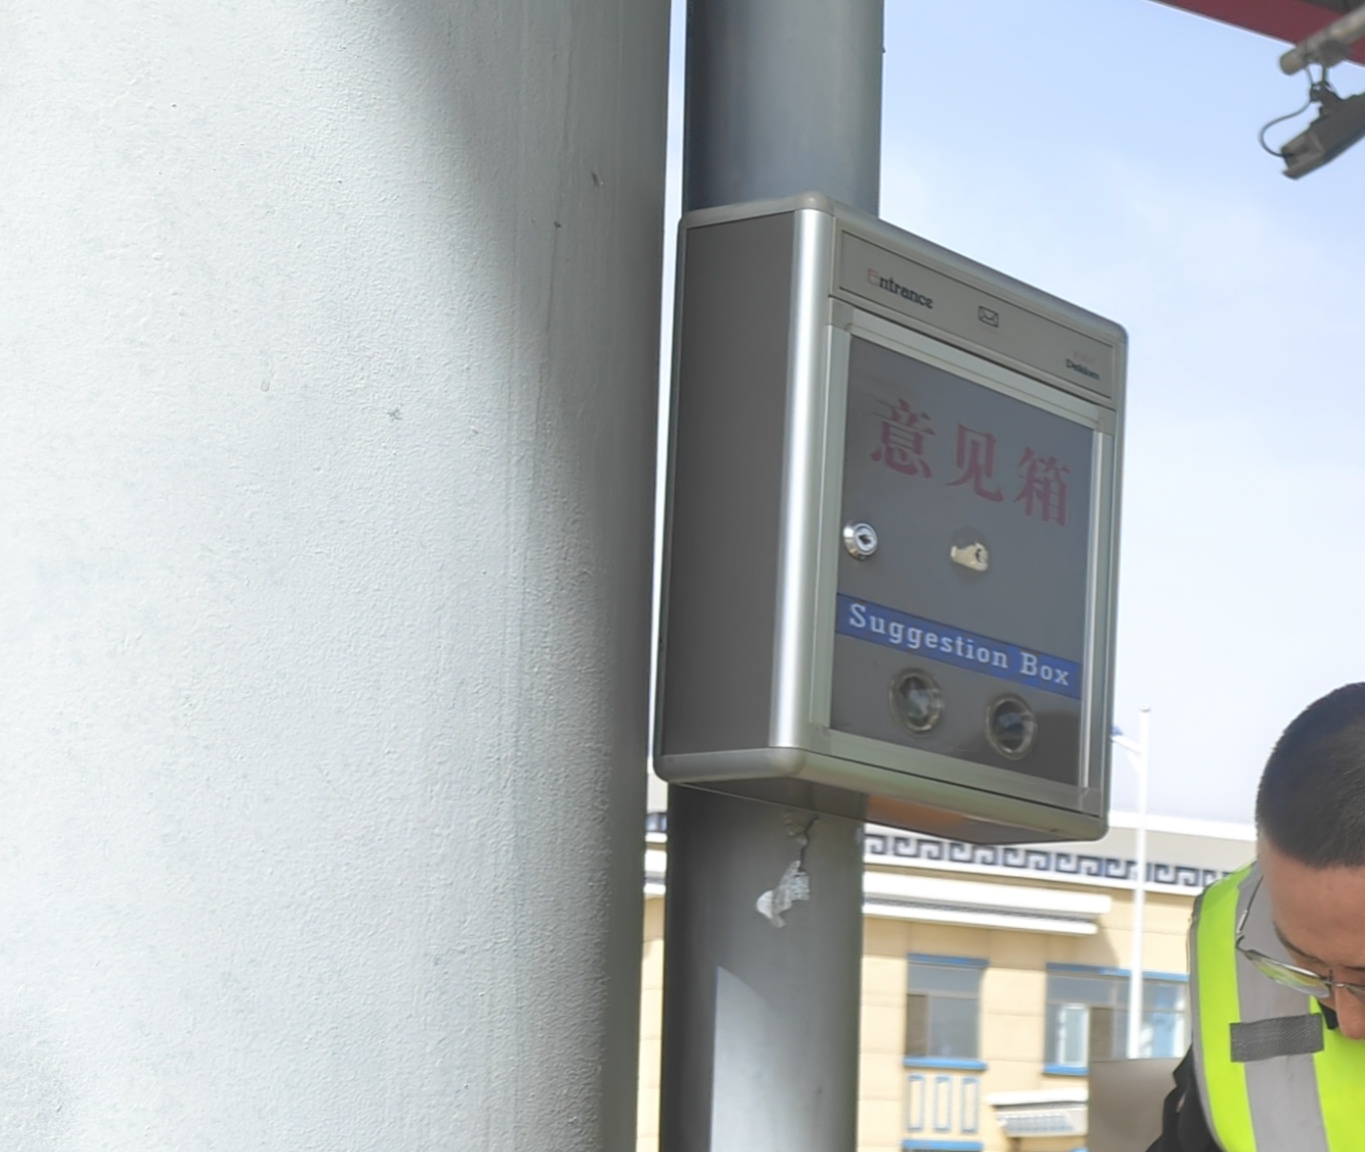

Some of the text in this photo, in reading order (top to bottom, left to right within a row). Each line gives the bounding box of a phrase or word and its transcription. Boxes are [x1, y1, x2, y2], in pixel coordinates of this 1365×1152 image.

[867, 268, 933, 309] Entrance
[870, 399, 1070, 526] 意见箱
[849, 603, 1070, 686] Suggestion Box
